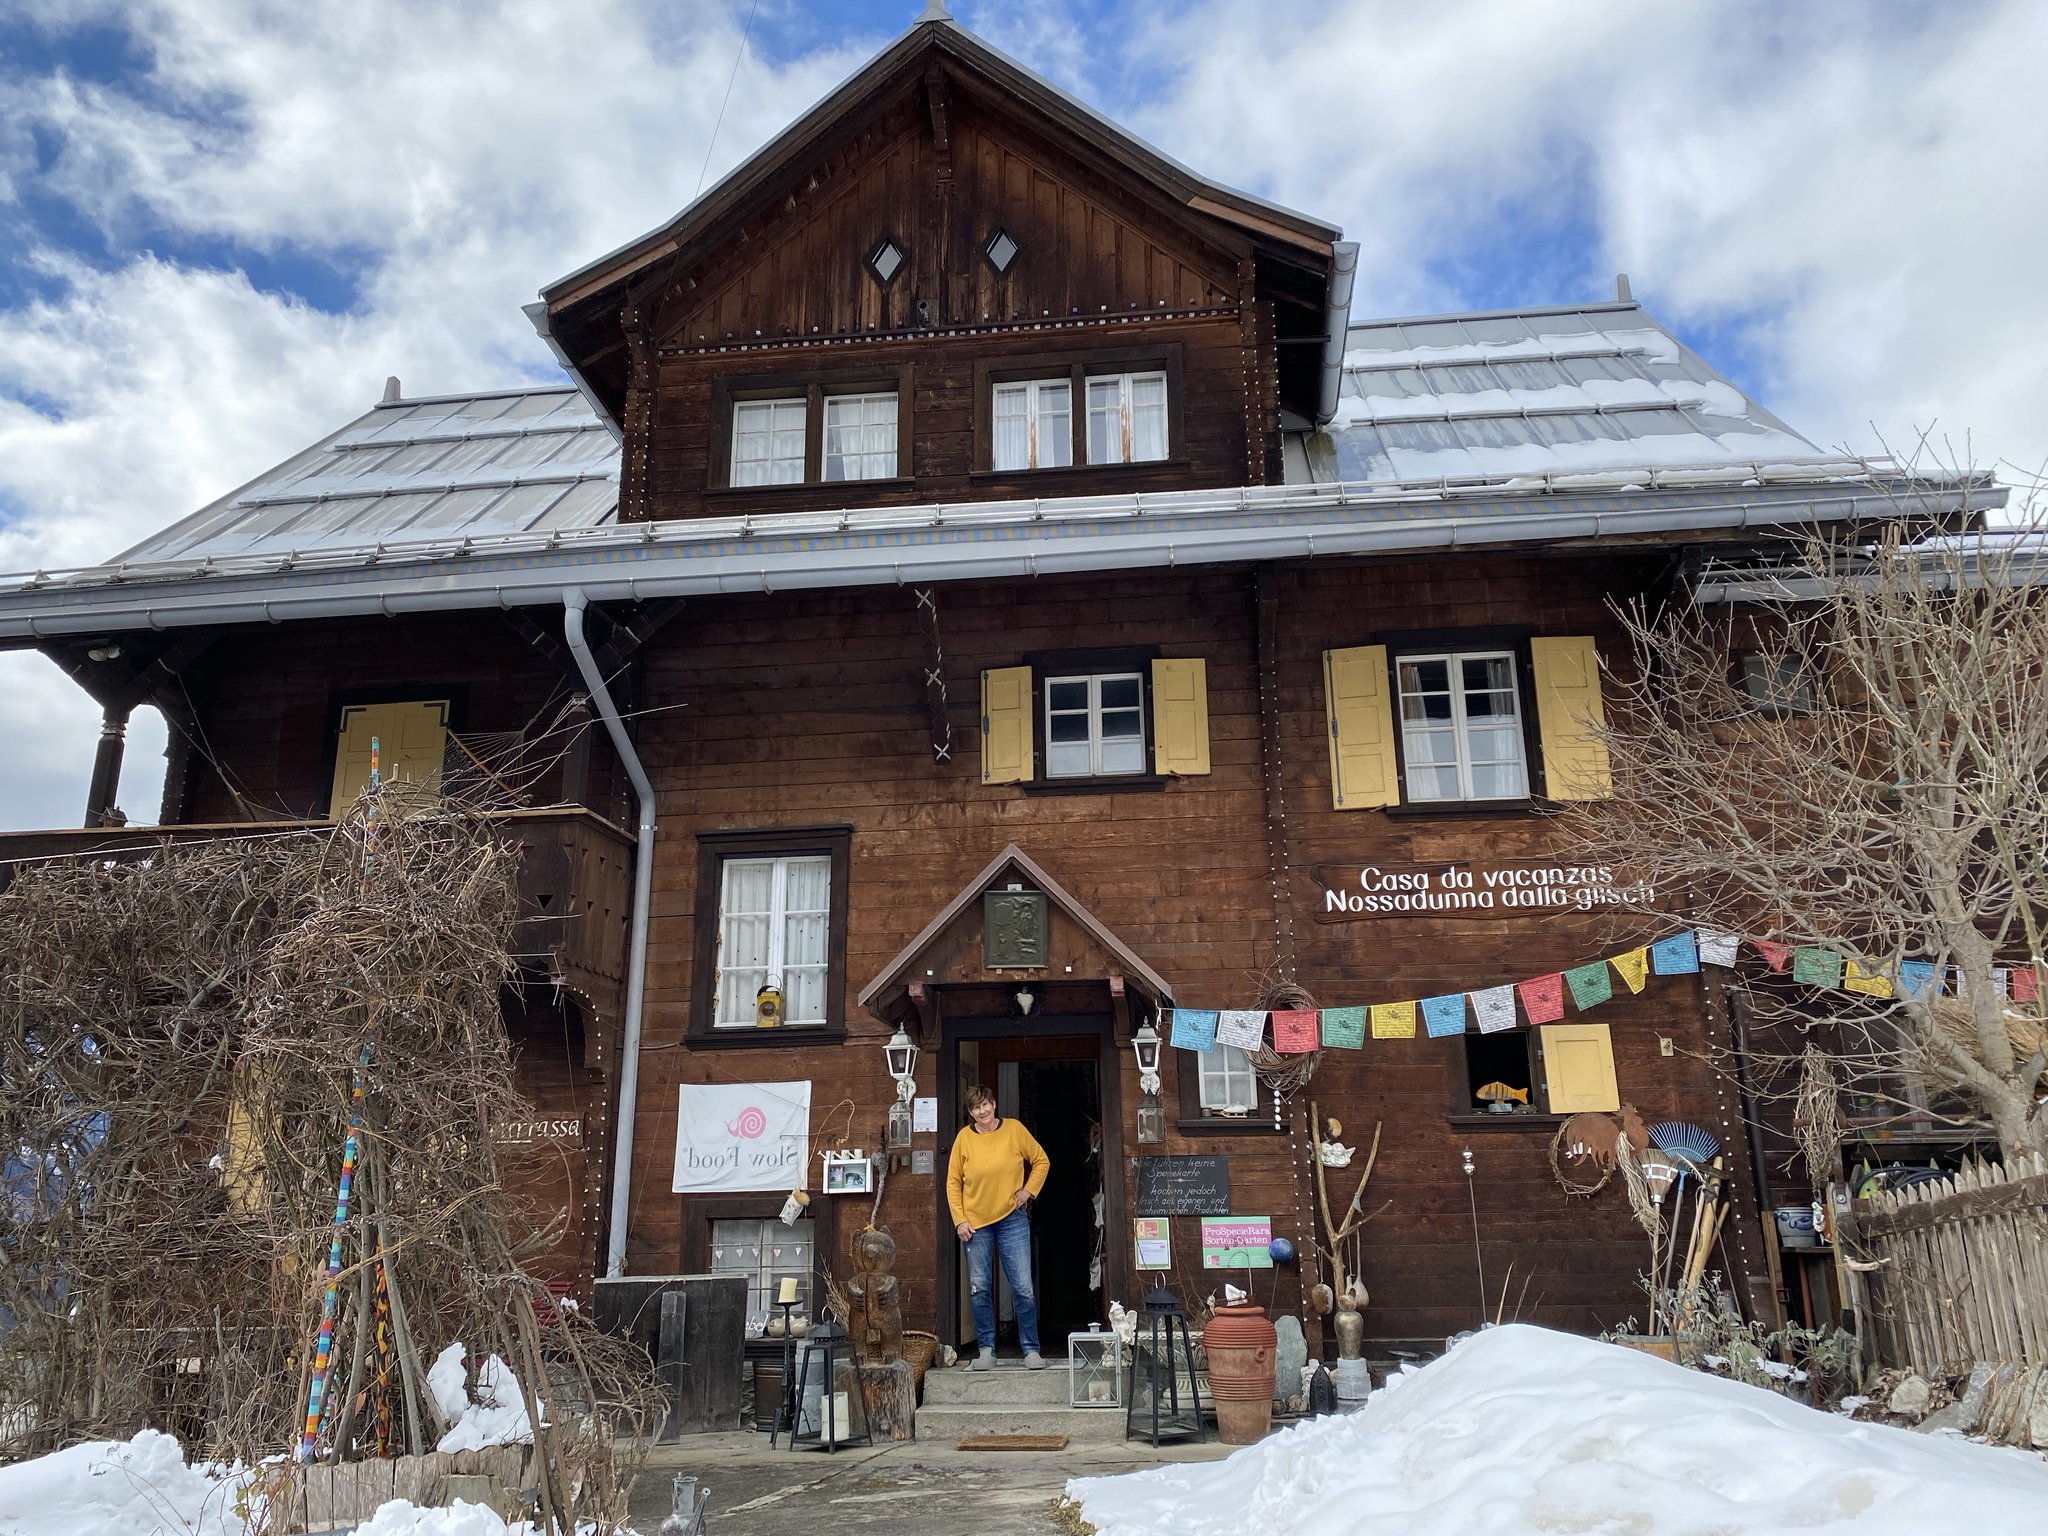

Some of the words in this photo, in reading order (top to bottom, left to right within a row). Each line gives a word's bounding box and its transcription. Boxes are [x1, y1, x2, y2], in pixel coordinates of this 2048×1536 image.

[1360, 866, 1430, 892] Casa
[1441, 865, 1473, 889] da
[1483, 866, 1613, 888] vacanzas
[1325, 888, 1494, 913] Nossadunna
[1502, 886, 1568, 908] dalla
[1185, 1184, 1216, 1199] jedoch
[1204, 1227, 1270, 1237] ProSpecieRara
